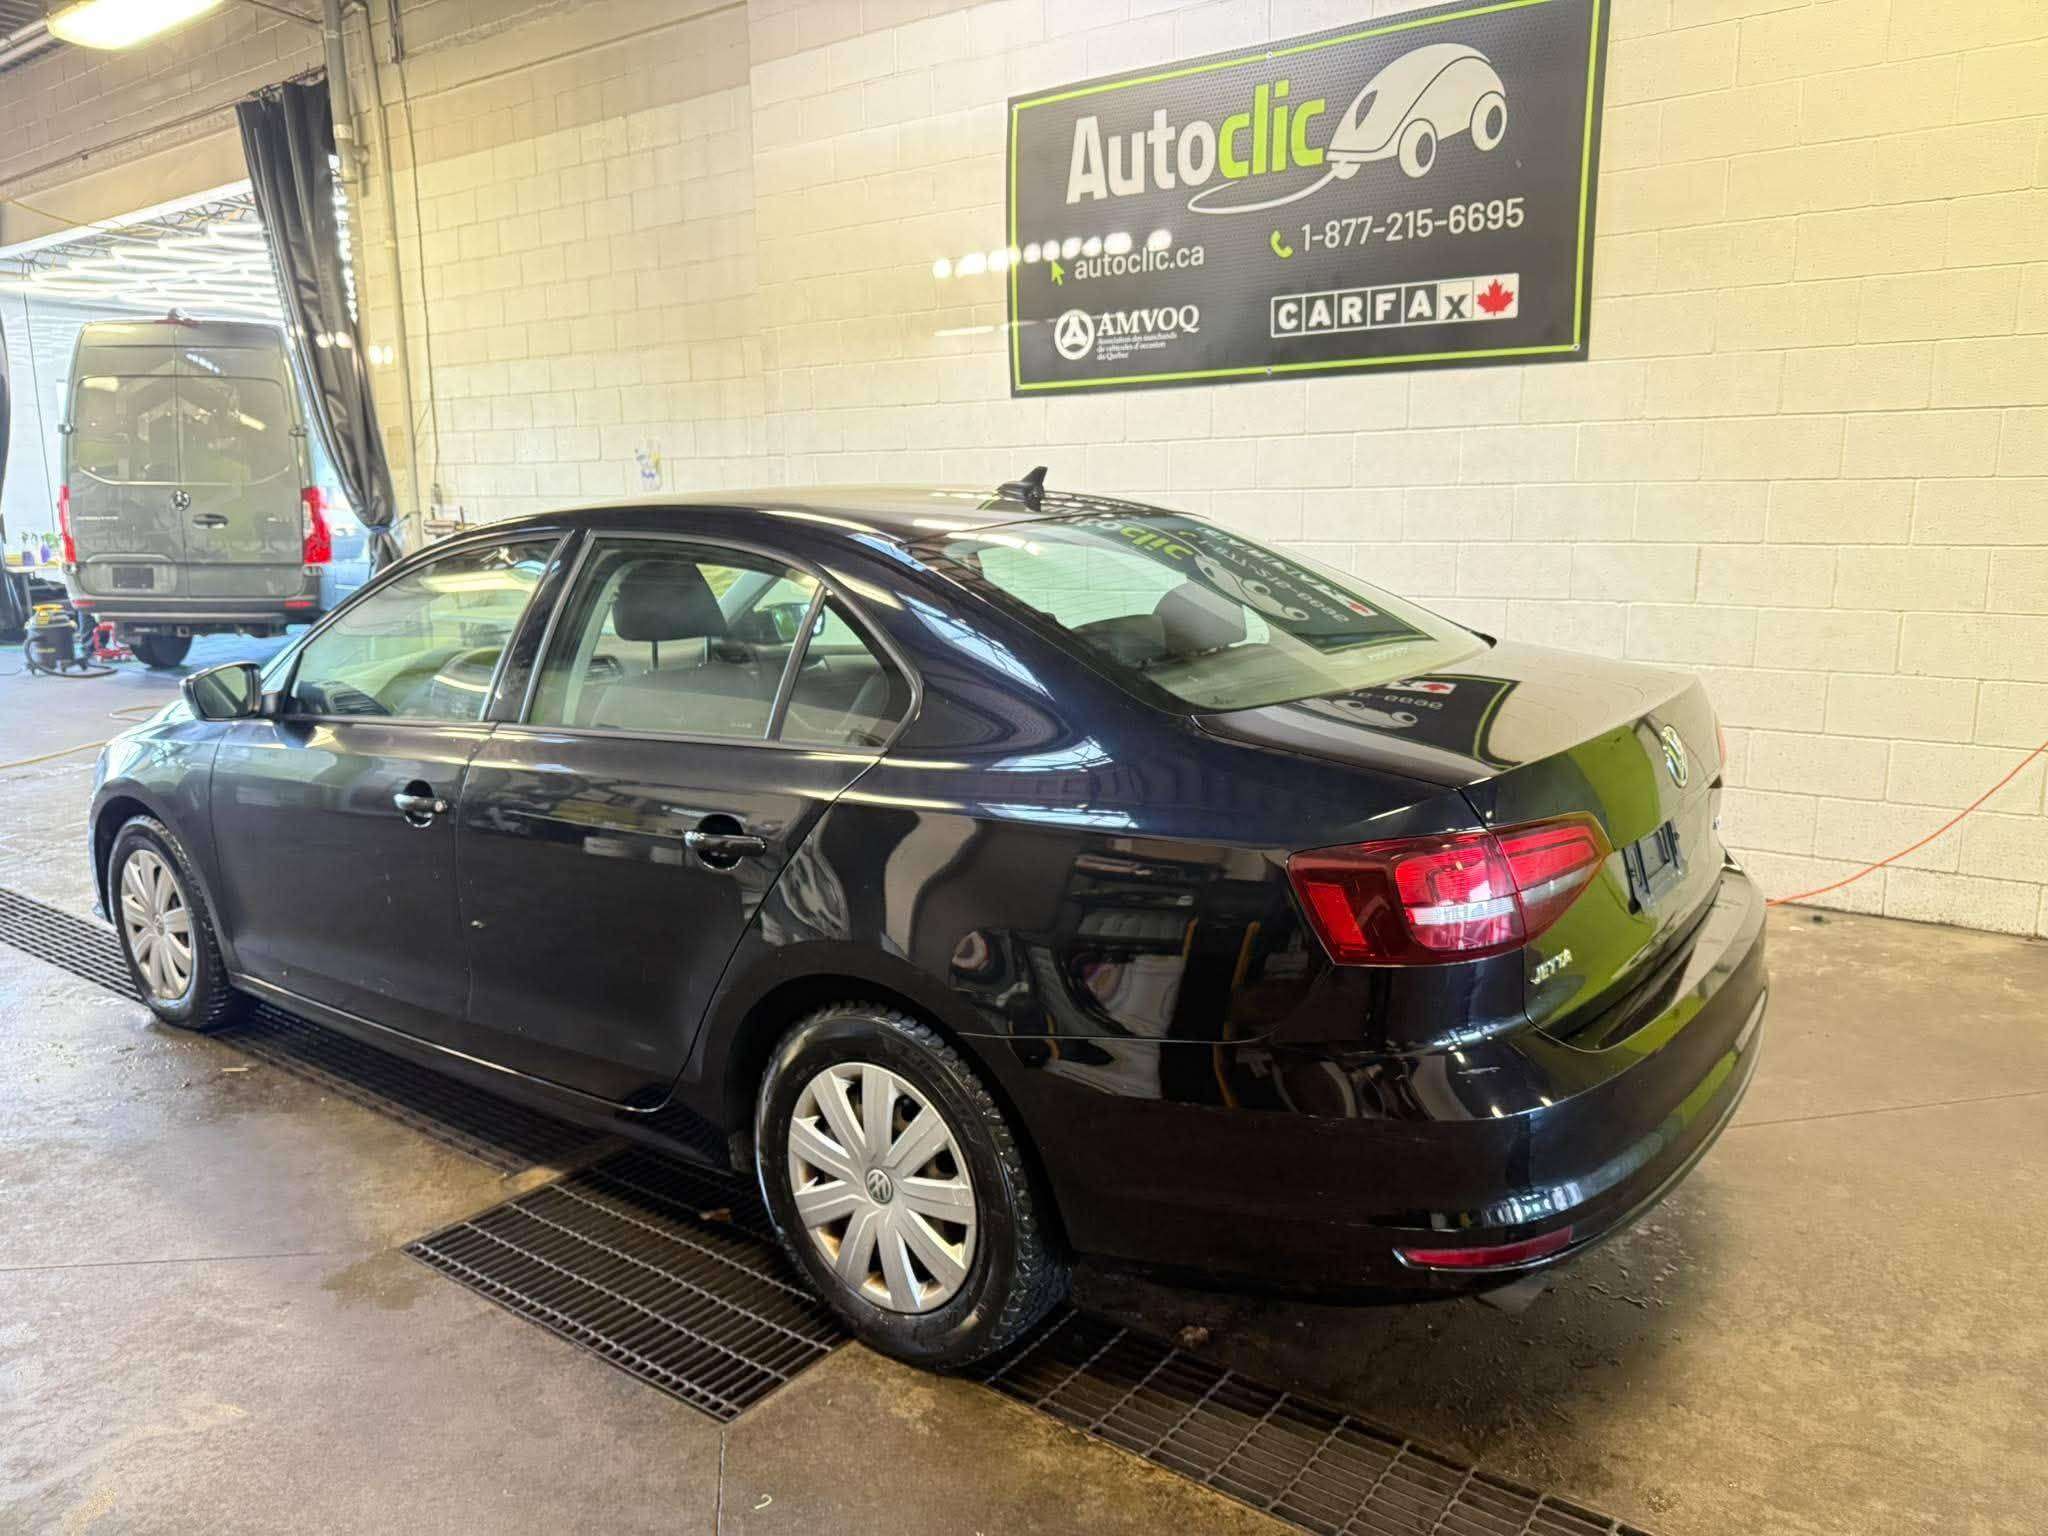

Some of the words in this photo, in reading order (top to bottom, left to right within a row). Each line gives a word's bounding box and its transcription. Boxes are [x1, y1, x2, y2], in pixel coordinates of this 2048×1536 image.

[1066, 79, 1325, 204] Autoclic
[1301, 197, 1525, 252] 1-877-215-6695
[1074, 245, 1205, 280] autoclic.ca
[1097, 305, 1200, 333] AMVOQ
[1277, 289, 1468, 330] CARFAX
[1530, 948, 1573, 985] JETTA
